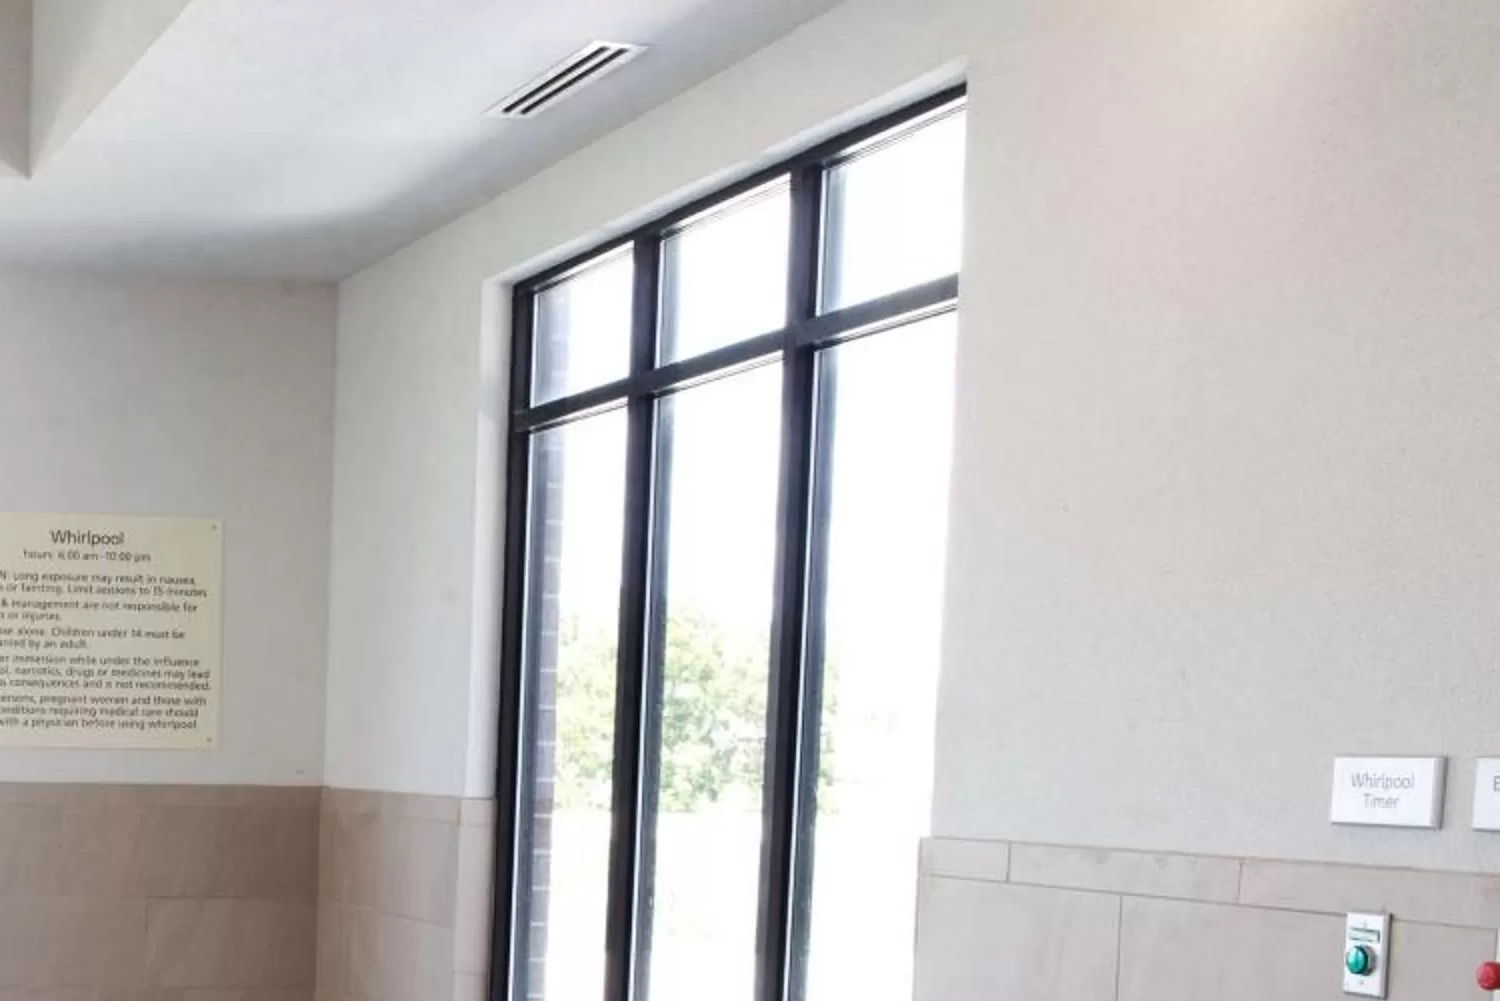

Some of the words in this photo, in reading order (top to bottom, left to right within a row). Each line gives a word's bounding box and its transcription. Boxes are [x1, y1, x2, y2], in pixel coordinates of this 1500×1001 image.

[50, 530, 125, 548] Whirlpool
[134, 553, 151, 563] pm
[12, 571, 39, 583] Long
[41, 573, 88, 584] exposure
[91, 575, 112, 585] may
[115, 574, 143, 584] result
[147, 574, 157, 584] in
[6, 583, 17, 593] or
[67, 583, 93, 594] Limit
[96, 586, 136, 596] sessions
[139, 586, 150, 596] to
[1, 598, 8, 609] &
[11, 599, 79, 611] management
[82, 601, 100, 611] are
[102, 602, 120, 612] not
[123, 602, 180, 614] responsible
[183, 601, 198, 613] for
[7, 612, 18, 621] or
[51, 627, 95, 638] Children
[98, 628, 127, 639] under
[144, 630, 169, 640] must
[171, 629, 185, 640] be
[28, 639, 41, 651] by
[43, 641, 57, 649] an
[13, 655, 67, 665] immersion
[69, 655, 97, 666] while
[100, 656, 130, 667] under
[133, 656, 150, 667] the
[153, 657, 200, 668] influence
[65, 667, 94, 680] drugs
[97, 669, 108, 679] or
[111, 668, 161, 680] medicines
[164, 671, 185, 682] may
[187, 669, 210, 680] lead
[10, 679, 80, 691] consequences
[83, 679, 103, 690] and
[116, 681, 133, 690] not
[40, 694, 87, 707] pregnant
[90, 696, 129, 706] women
[131, 695, 151, 706] and
[153, 695, 181, 707] those
[183, 696, 207, 707] with
[50, 706, 97, 719] requiring
[100, 706, 139, 718] medical
[142, 709, 162, 719] care
[165, 707, 199, 719] should
[22, 719, 30, 728] a
[31, 718, 79, 730] physician
[81, 718, 116, 729] before
[118, 719, 145, 731] using
[1351, 771, 1415, 791] Whirlpool
[1363, 793, 1399, 809] Timer
